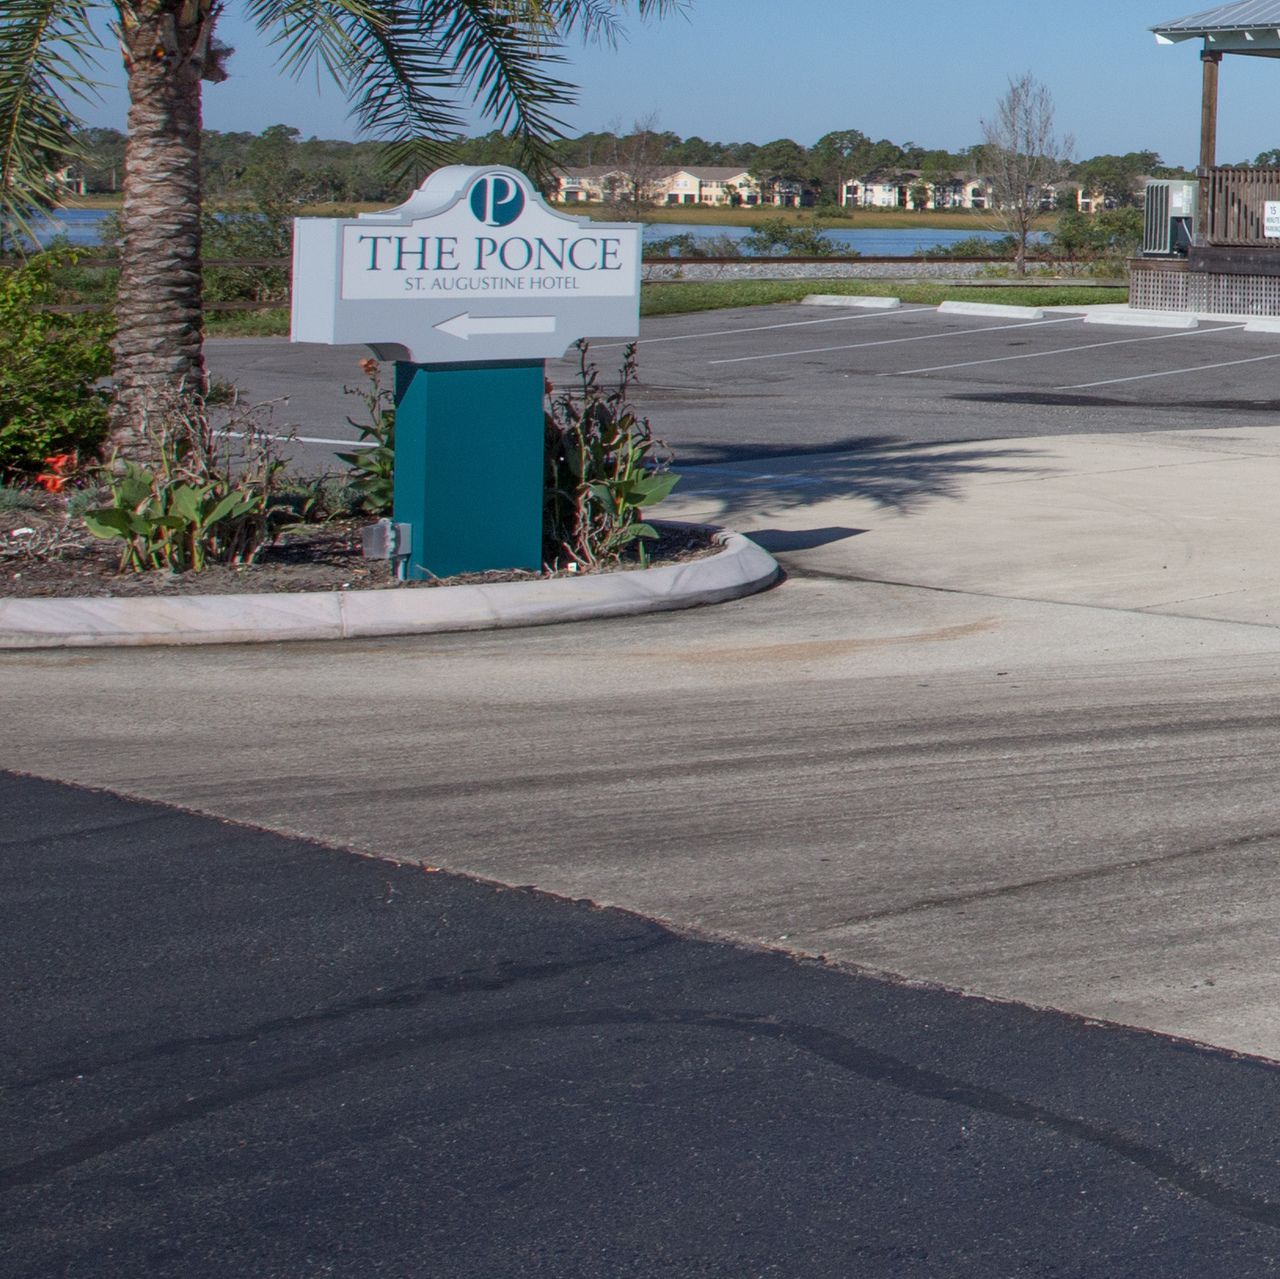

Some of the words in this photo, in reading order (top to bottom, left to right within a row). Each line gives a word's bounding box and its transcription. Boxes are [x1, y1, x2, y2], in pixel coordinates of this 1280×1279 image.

[480, 175, 517, 225] P
[1270, 206, 1277, 215] 15
[358, 235, 461, 271] THE
[473, 236, 623, 271] PONCE
[405, 277, 426, 291] ST.
[431, 276, 525, 290] AUGUSTINE
[530, 276, 580, 290] HOTEL
